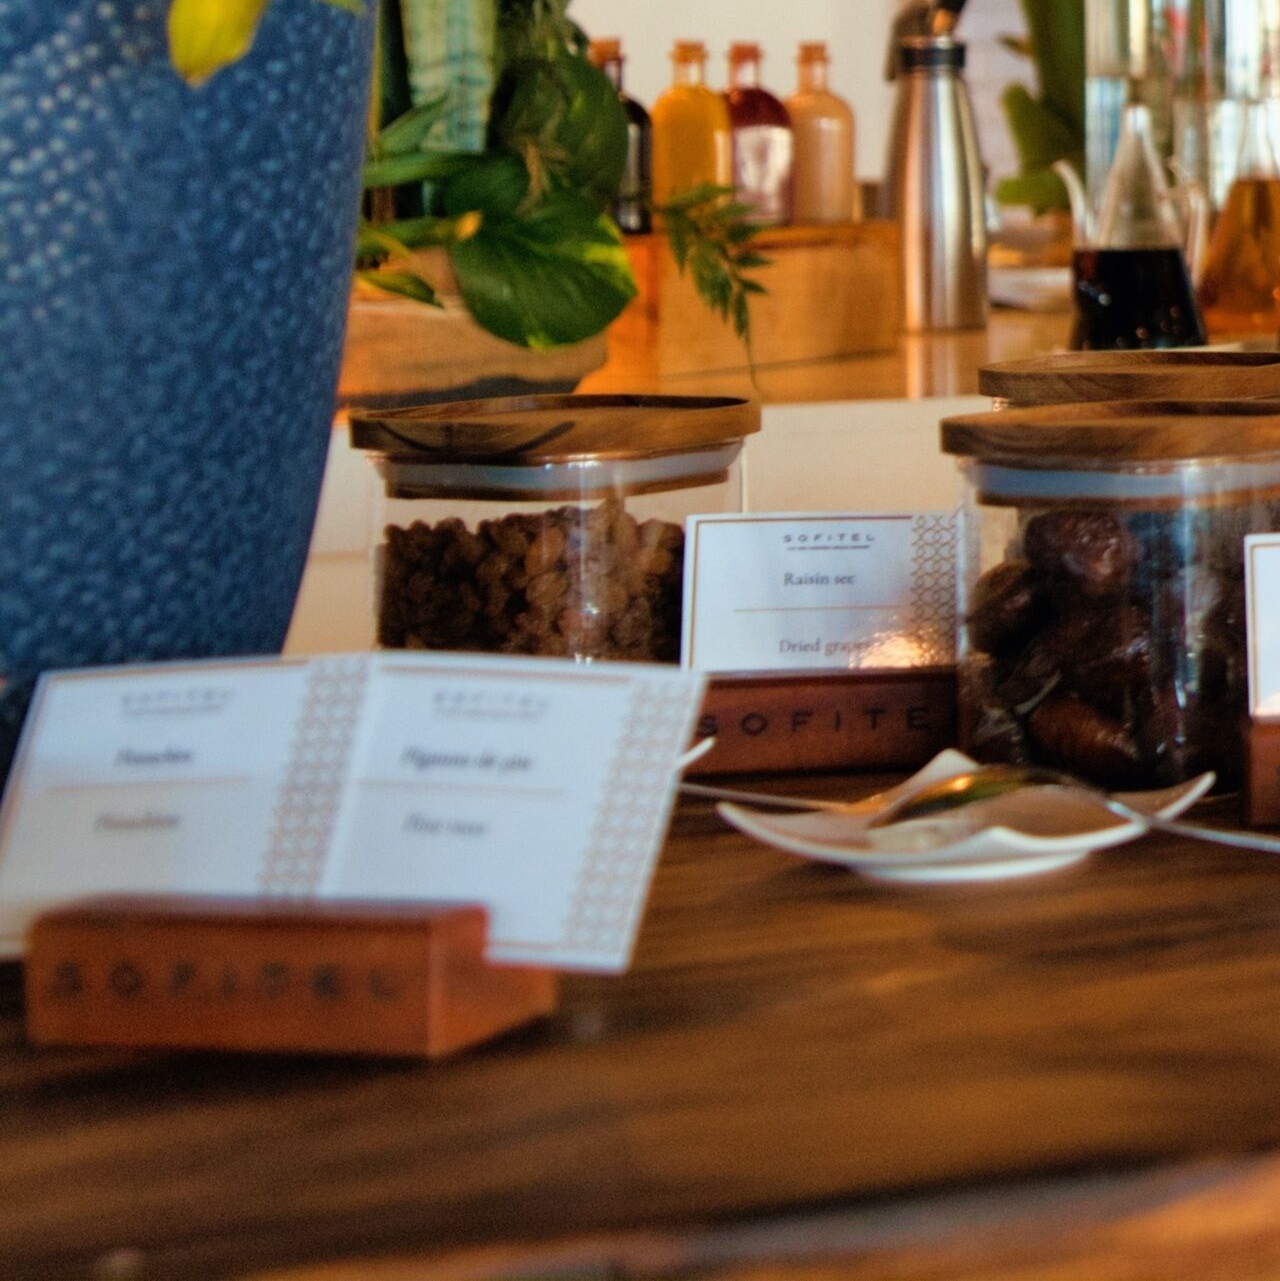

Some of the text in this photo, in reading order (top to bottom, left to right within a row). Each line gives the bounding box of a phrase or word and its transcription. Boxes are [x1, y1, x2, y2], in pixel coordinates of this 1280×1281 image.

[783, 532, 876, 543] SOFITEL
[783, 572, 856, 586] Raisin sec
[779, 637, 821, 653] Dried
[696, 704, 930, 737] SOFITE
